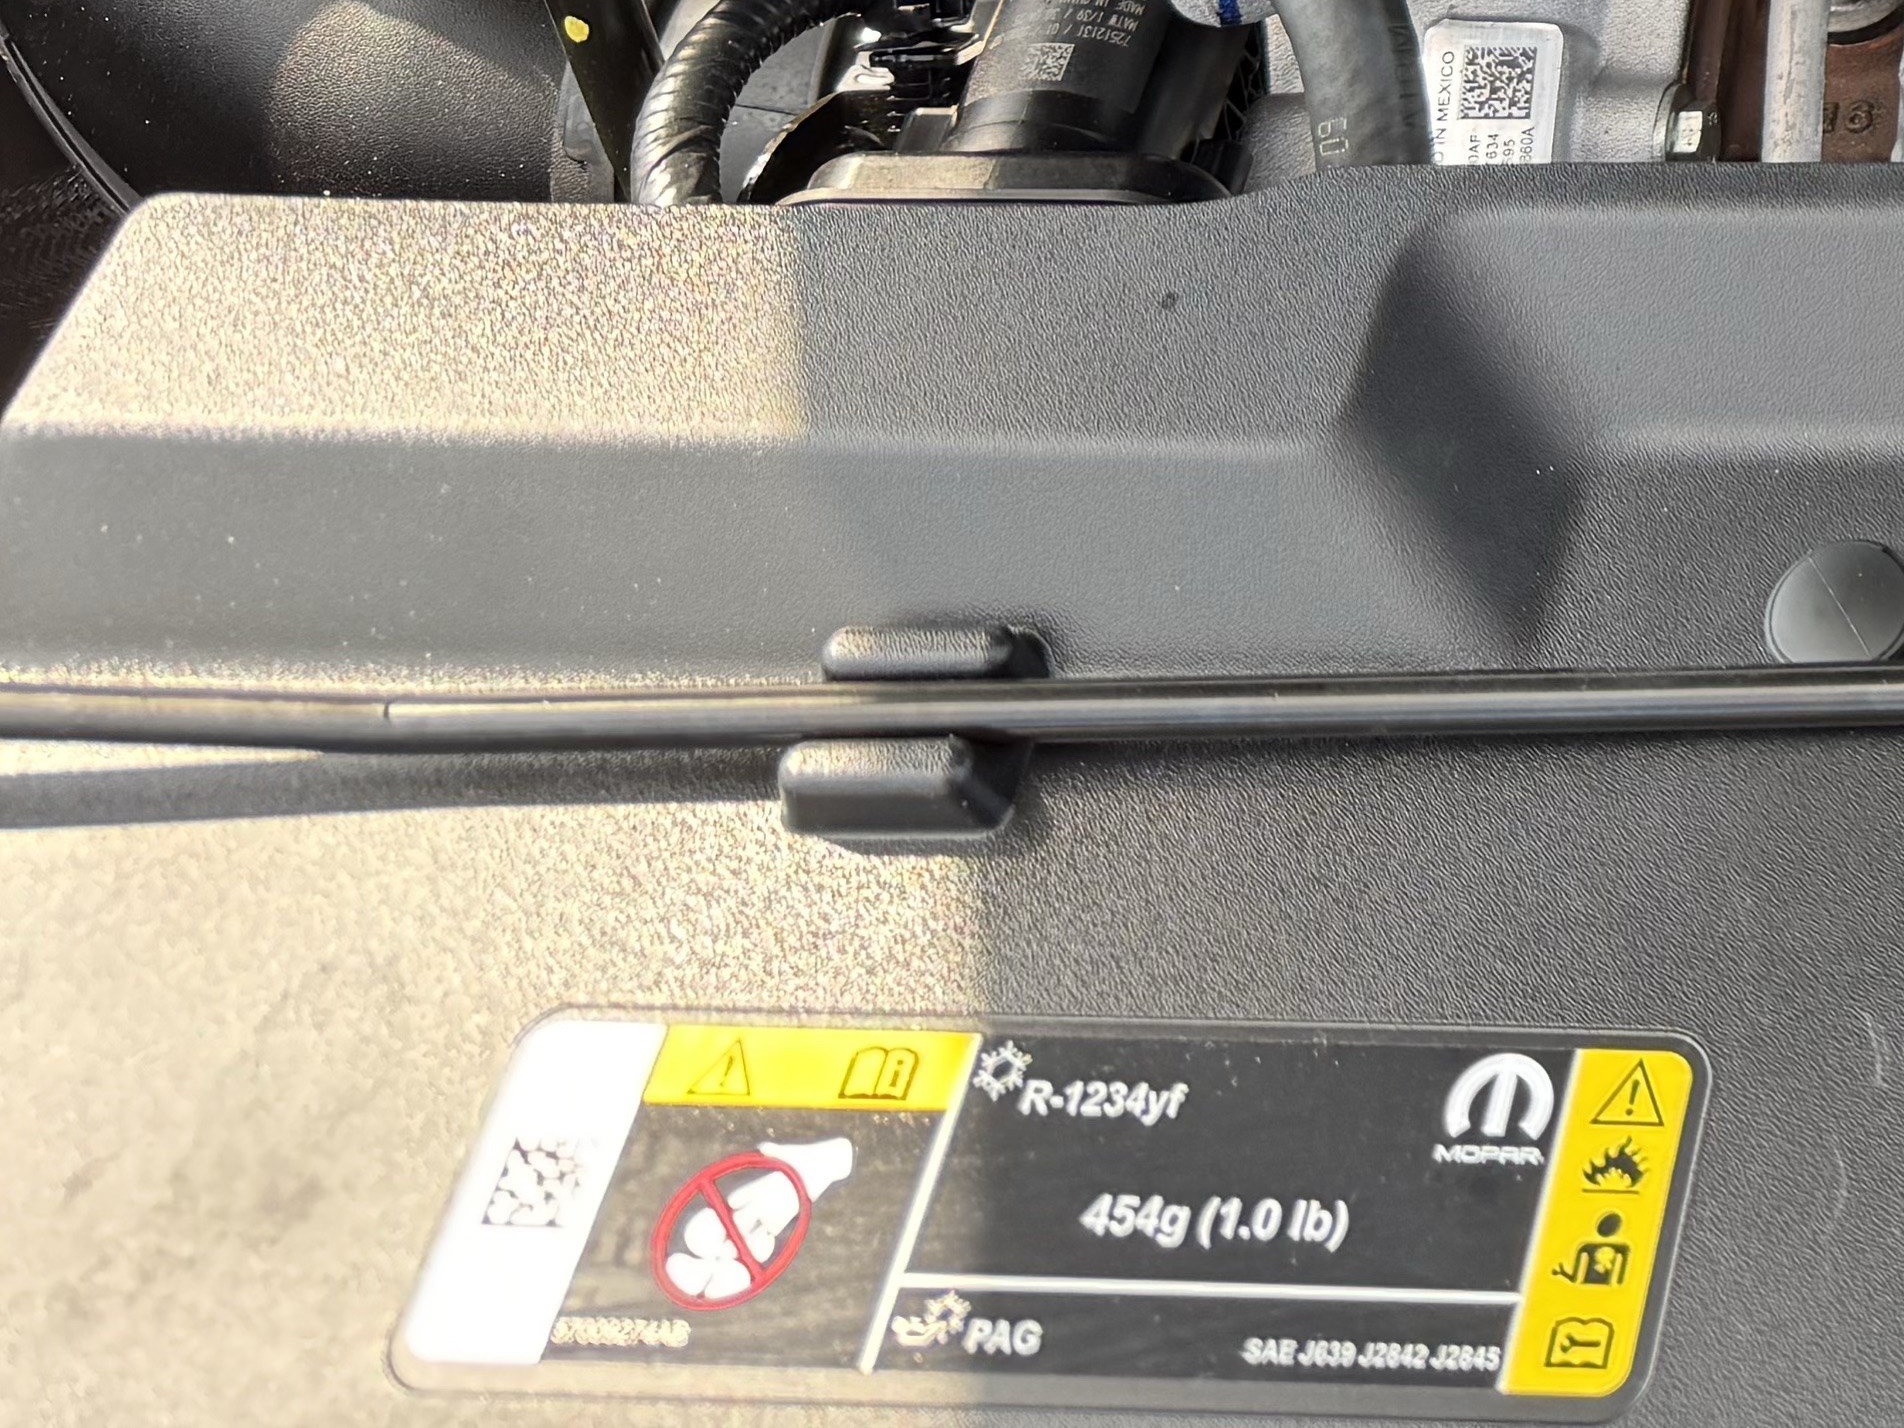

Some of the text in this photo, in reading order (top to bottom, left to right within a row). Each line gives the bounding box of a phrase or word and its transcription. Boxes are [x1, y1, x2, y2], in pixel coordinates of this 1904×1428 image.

[1436, 51, 1455, 122] MEXICO
[1433, 127, 1447, 145] IN
[1017, 1080, 1189, 1126] R-1234yf
[1432, 1143, 1546, 1167] MOPAR
[1079, 1192, 1350, 1253] 454g (1.0 lb)
[961, 1317, 1044, 1357] PAG
[1240, 1337, 1299, 1367] SAE
